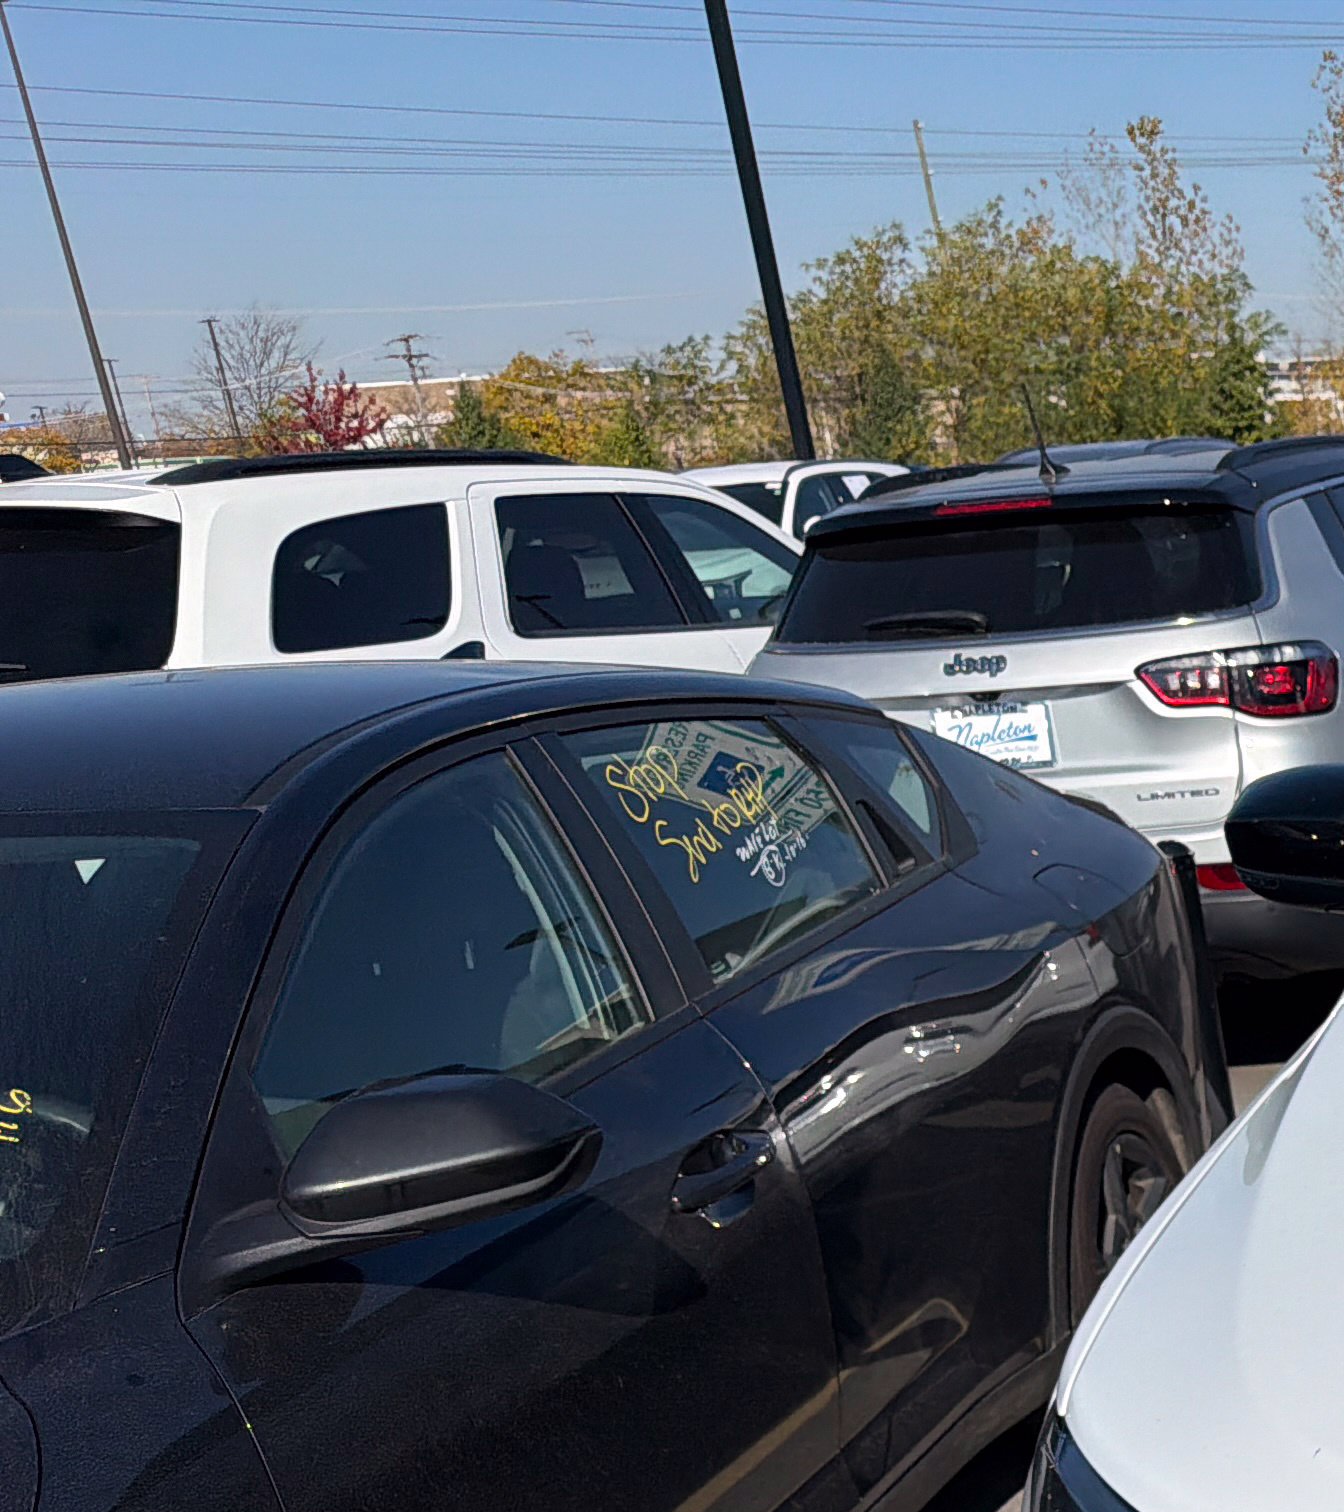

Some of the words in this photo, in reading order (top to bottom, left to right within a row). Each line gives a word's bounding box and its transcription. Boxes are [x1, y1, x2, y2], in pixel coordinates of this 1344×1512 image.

[942, 652, 1008, 678] Jeep
[948, 713, 1034, 751] Napleton
[1136, 787, 1219, 801] LIMITED
